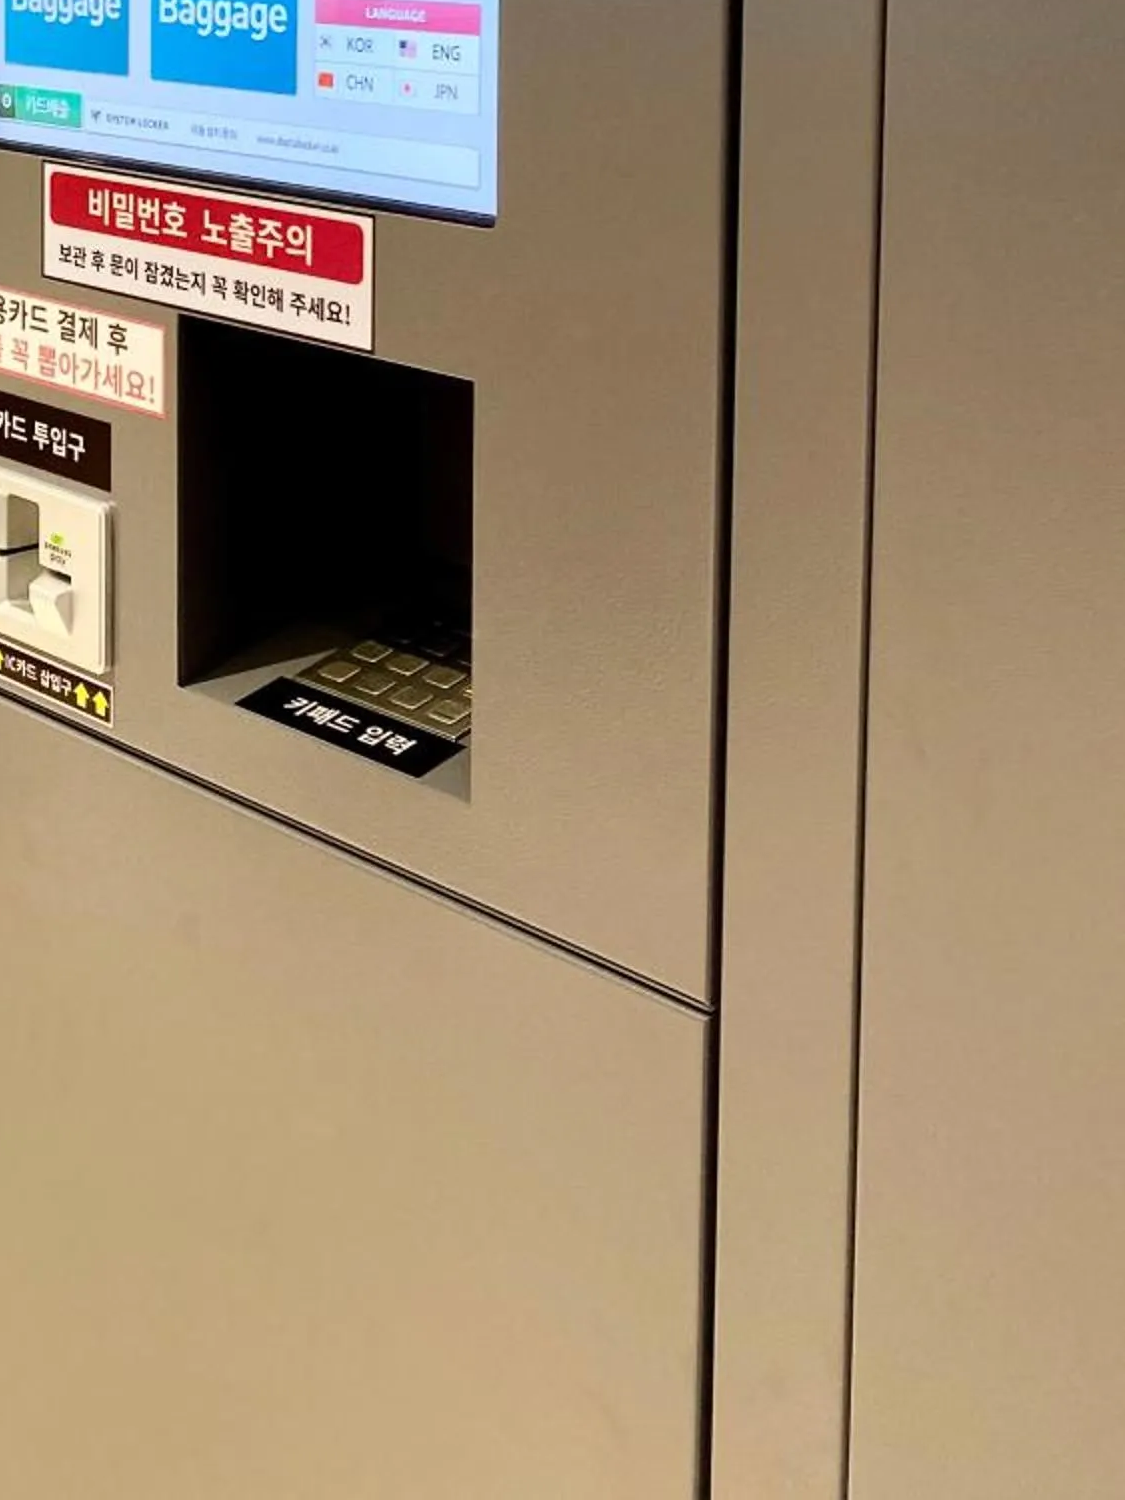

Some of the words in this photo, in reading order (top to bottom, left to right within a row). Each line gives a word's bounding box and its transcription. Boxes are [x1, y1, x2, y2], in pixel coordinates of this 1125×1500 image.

[365, 6, 427, 23] LANGUAGE
[347, 37, 374, 53] KOR
[432, 44, 461, 61] ENG
[346, 74, 374, 92] CHN
[434, 84, 458, 100] JPN
[87, 187, 188, 239] 비밀번호
[201, 209, 314, 267] 노출주의
[59, 243, 88, 269] 보관
[90, 250, 106, 273] 후
[109, 253, 140, 281] 문이
[143, 261, 207, 298] 잠겼는지
[211, 275, 229, 300] 꼭
[233, 279, 285, 313] 확인해
[290, 291, 352, 327] 주세요!
[57, 308, 99, 350] 결제
[106, 322, 129, 356] 후
[10, 337, 30, 372] 꼭
[37, 343, 156, 404] 뽑아가세요!
[32, 420, 86, 463] 투입구
[40, 668, 72, 697] 삽입구
[283, 696, 361, 734] 키패드
[357, 725, 418, 756] 입력
